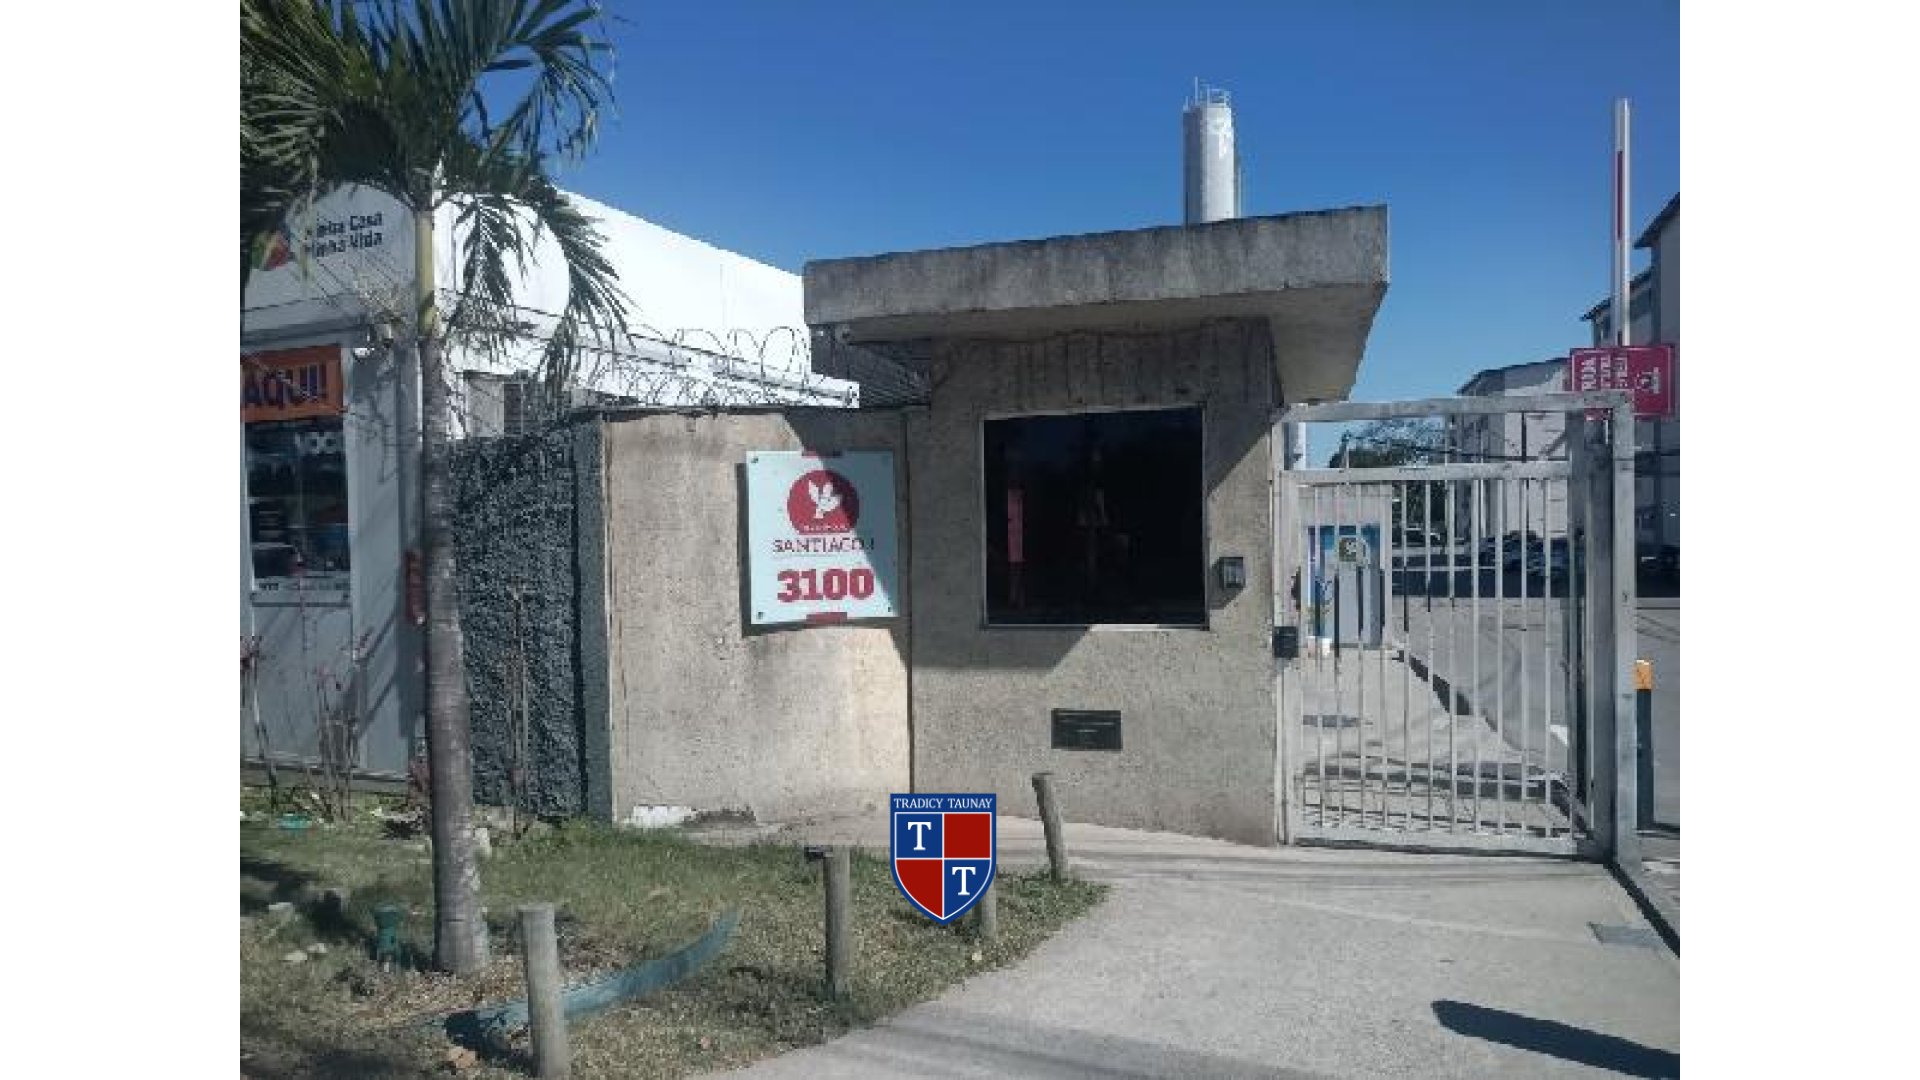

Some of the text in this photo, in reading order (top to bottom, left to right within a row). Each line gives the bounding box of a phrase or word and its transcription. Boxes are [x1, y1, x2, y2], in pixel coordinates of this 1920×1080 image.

[349, 211, 382, 231] Casa
[349, 231, 382, 250] Vida
[776, 567, 875, 603] 3100
